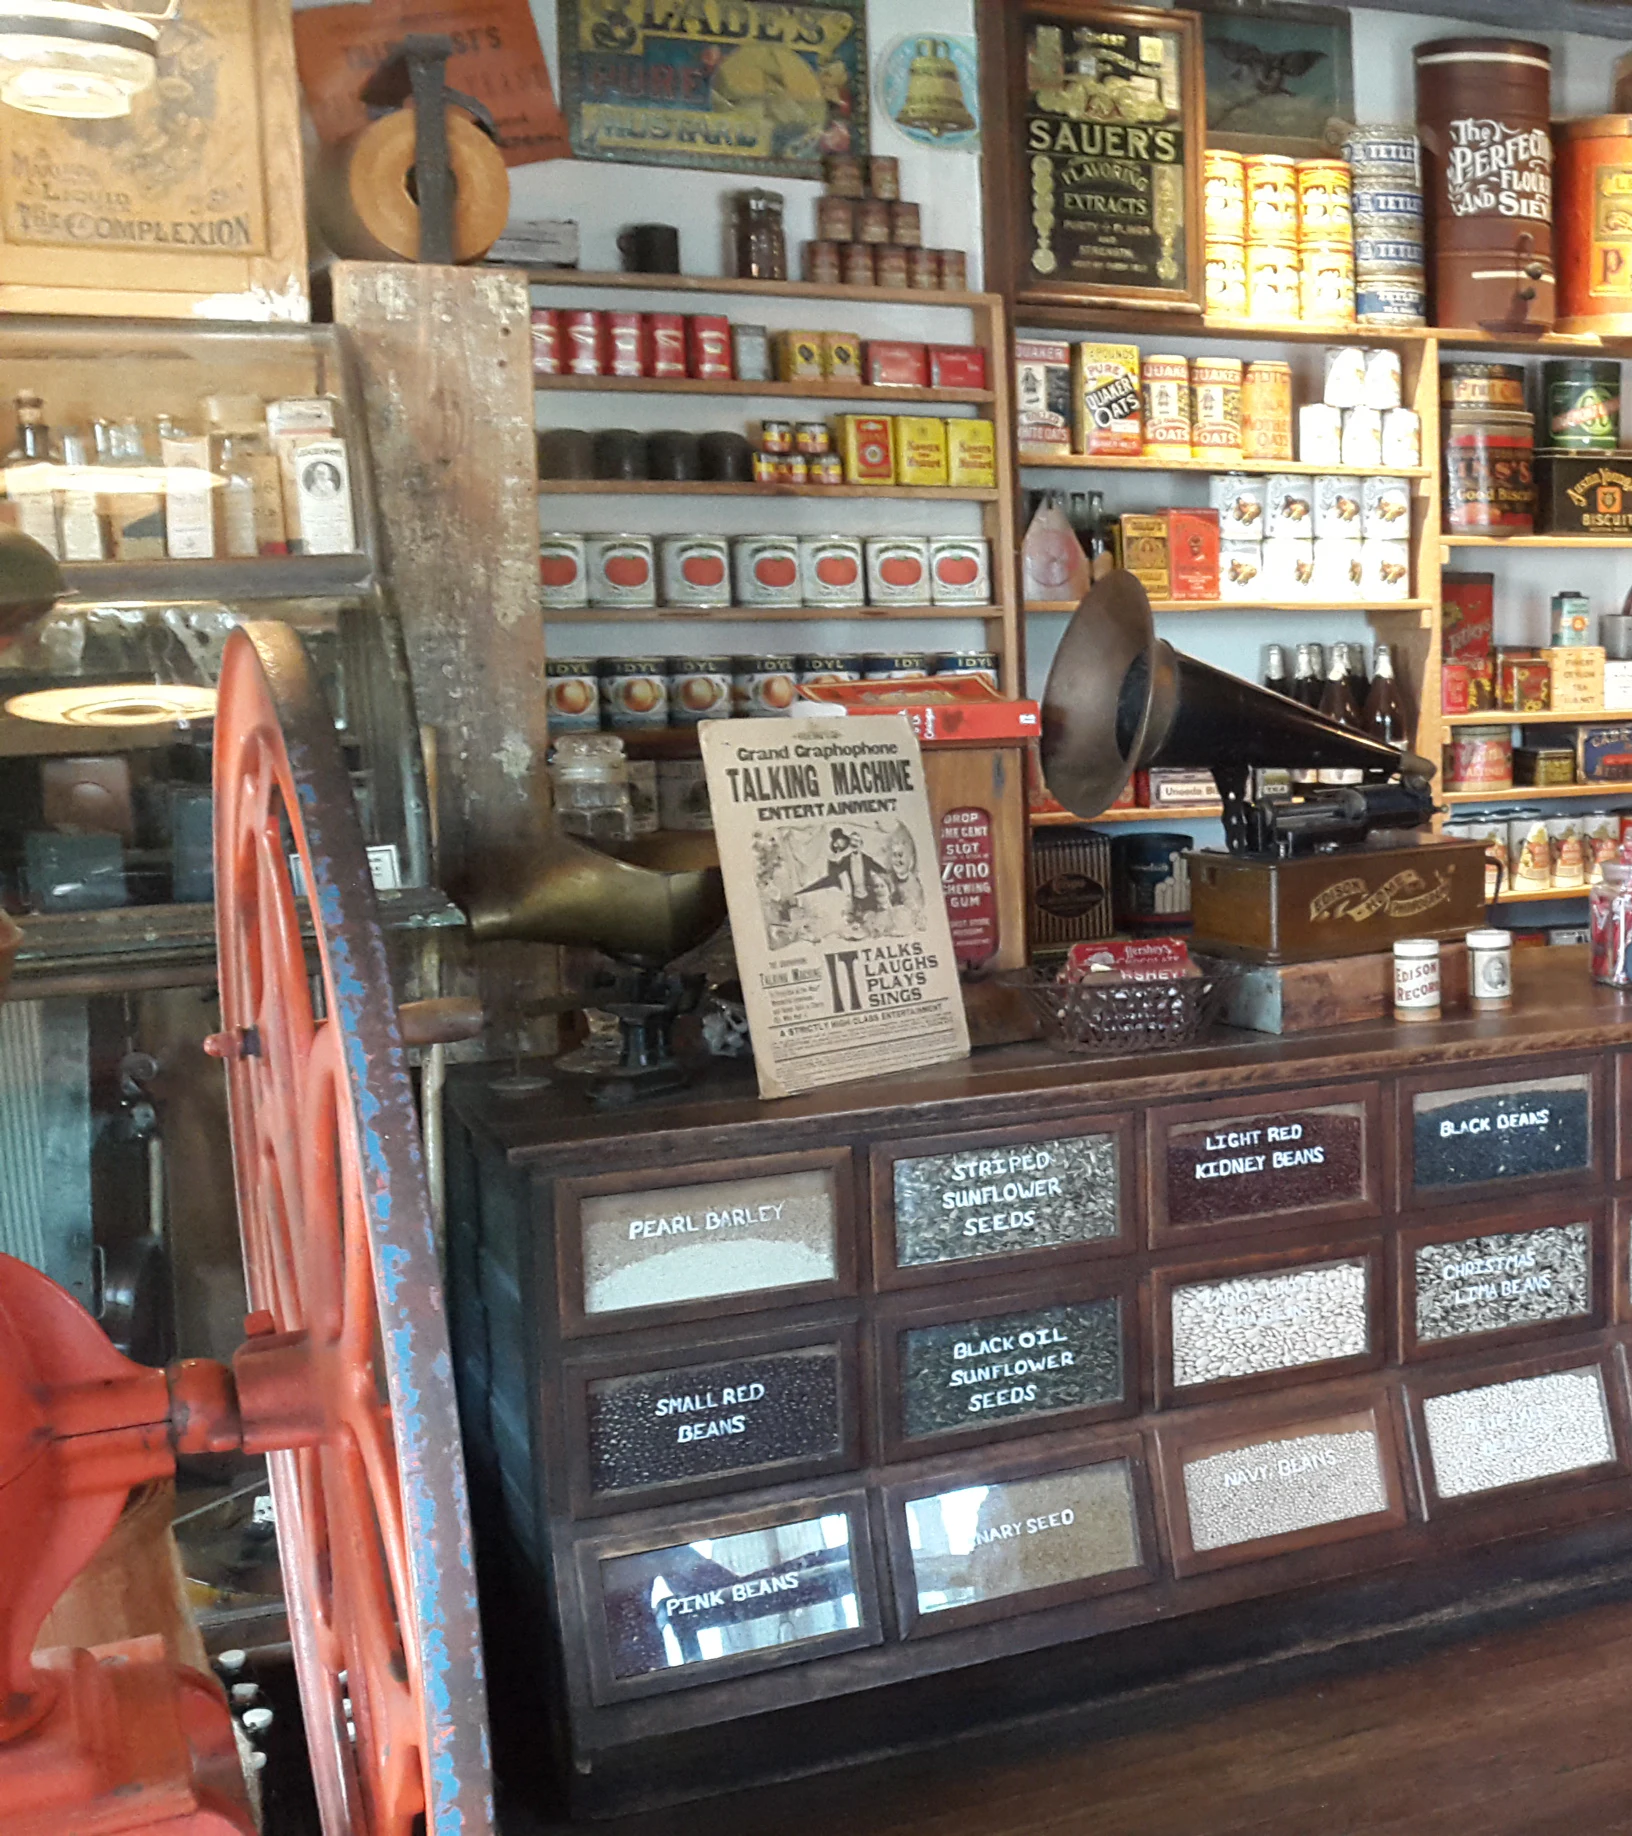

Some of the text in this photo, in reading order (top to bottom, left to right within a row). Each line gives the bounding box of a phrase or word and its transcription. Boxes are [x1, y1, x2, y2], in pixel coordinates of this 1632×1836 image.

[593, 62, 701, 100] PURE
[1028, 118, 1177, 162] SAUER'S
[1456, 118, 1492, 147] The
[1450, 127, 1549, 186] PERFECT
[1061, 161, 1149, 193] FLAVORING
[1063, 192, 1149, 216] EXTRACTS
[64, 211, 251, 247] COMPLEXION
[1088, 365, 1121, 377] PURE
[1144, 366, 1188, 380] QUAKE
[1086, 377, 1133, 409] QUAKER
[1094, 393, 1140, 429] OATS
[685, 660, 717, 672] DYL
[894, 657, 923, 669] IDY
[957, 657, 994, 669] IDYL
[737, 741, 899, 762] Grand Graphophone
[724, 759, 914, 803] TALKING MACHINE
[1165, 786, 1203, 796] Uneeda
[1265, 786, 1285, 794] TEA
[756, 798, 898, 822] ENTERTAINMENT
[943, 813, 979, 825] DROP
[961, 826, 988, 838] CENT
[946, 842, 980, 855] SLOT
[940, 861, 990, 884] Zeno
[943, 882, 991, 896] CHEWING
[950, 895, 981, 908] GUM
[861, 941, 924, 963] TALKS
[863, 954, 940, 977] LAUGHS
[866, 971, 928, 993] PLAYS
[1395, 961, 1438, 983] EDISON
[868, 986, 923, 1008] SINGS
[779, 1029, 787, 1038] A
[787, 1020, 830, 1038] STRICTLY
[852, 1013, 880, 1026] CLASS
[880, 1003, 944, 1021] ENTERTAINMENT
[1205, 1123, 1303, 1152] LIGHT RED
[1439, 1108, 1550, 1138] BLACK BEANS
[950, 1150, 1052, 1182] STRIPED
[1194, 1145, 1325, 1181] KIDNEY BEANS
[942, 1176, 1062, 1211] SUNFLOWER
[628, 1201, 786, 1240] PEARL BARLEY
[962, 1209, 1036, 1238] SEEDS
[1442, 1250, 1536, 1281] CHRISTMAS
[1454, 1272, 1552, 1304] LIMA BEANS
[953, 1328, 1068, 1361] BLACK OIL
[948, 1350, 1076, 1388] SUNFLOWER
[654, 1382, 766, 1418] SMALL RED
[967, 1384, 1038, 1412] SEEDS
[677, 1414, 747, 1444] BEANS
[1223, 1447, 1338, 1489] NAVY BEANS
[1026, 1508, 1076, 1536] SEED
[666, 1571, 800, 1618] PINK BEANS
